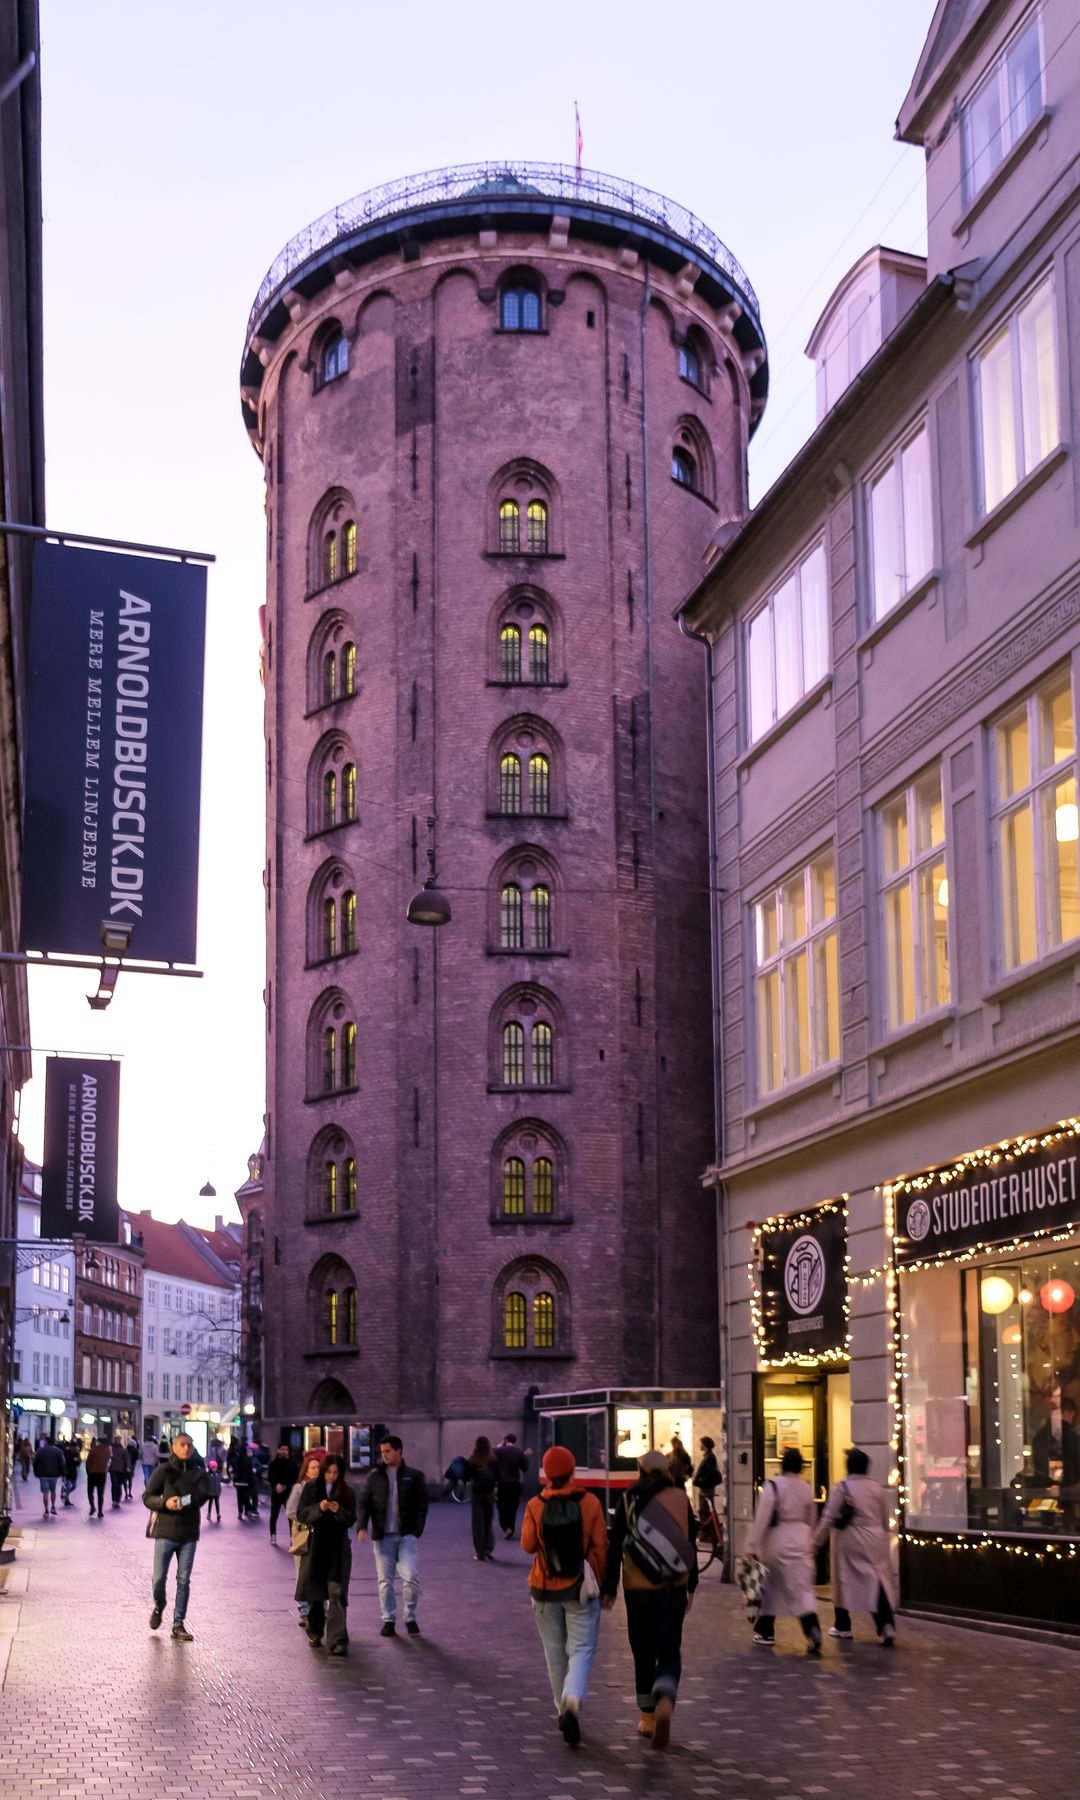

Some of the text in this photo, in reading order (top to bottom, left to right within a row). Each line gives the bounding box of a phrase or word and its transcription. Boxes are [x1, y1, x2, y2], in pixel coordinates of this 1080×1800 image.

[82, 609, 104, 888] MERE MELLEM LINJERNE
[110, 589, 151, 917] ARNOLDBUSCK.DK
[78, 1074, 97, 1222] ARNOLDBUSCK.DK
[932, 1156, 1077, 1235] STUDENTERHUSET
